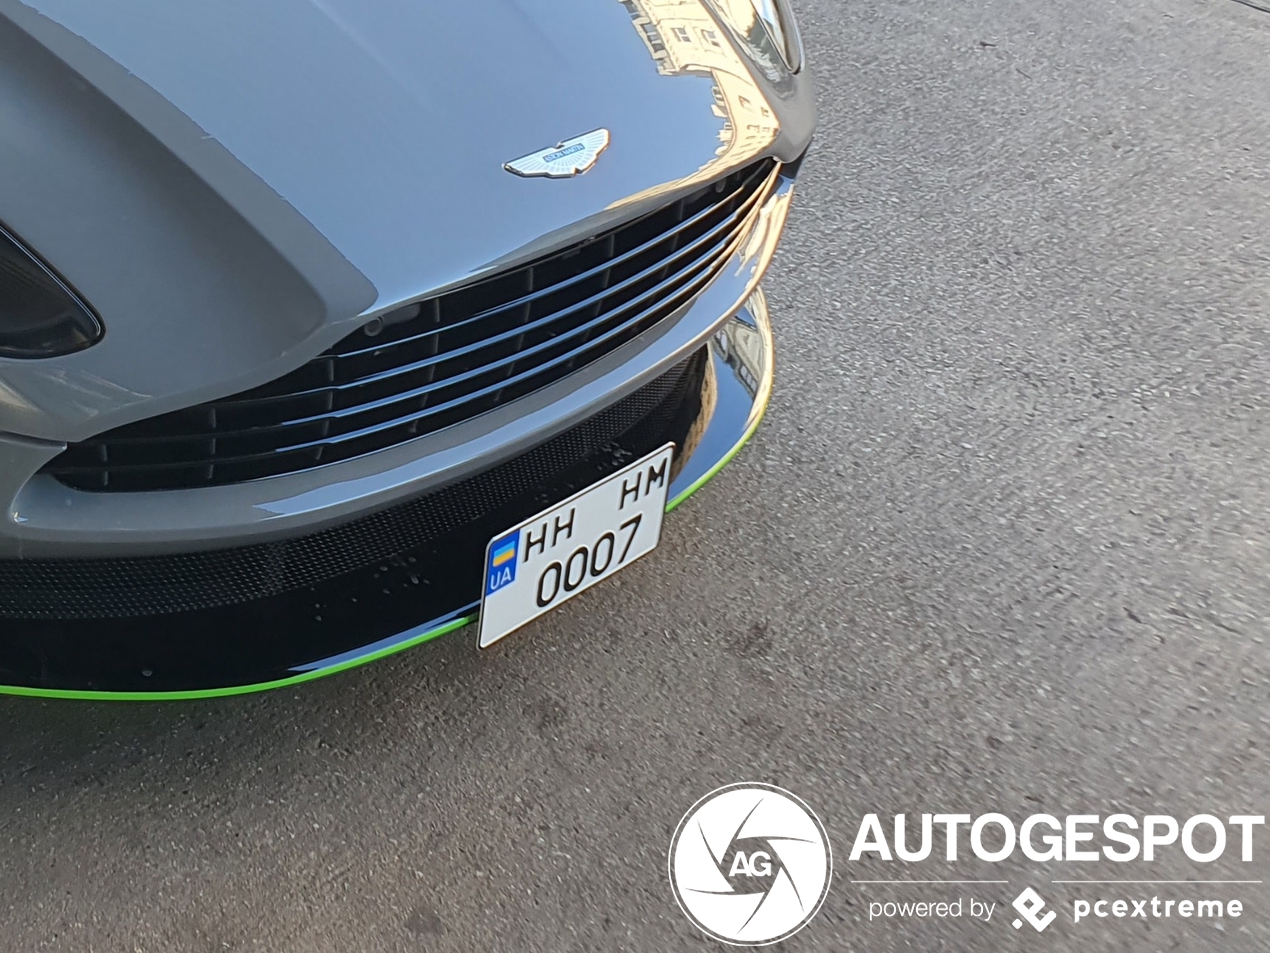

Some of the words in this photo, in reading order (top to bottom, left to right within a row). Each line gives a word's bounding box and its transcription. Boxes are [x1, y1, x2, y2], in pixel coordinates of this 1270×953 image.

[544, 152, 564, 163] ASTON
[562, 144, 584, 155] MARTIN
[523, 507, 576, 562] HH
[618, 457, 668, 511] HM
[490, 566, 512, 590] UA
[536, 512, 643, 608] 0007
